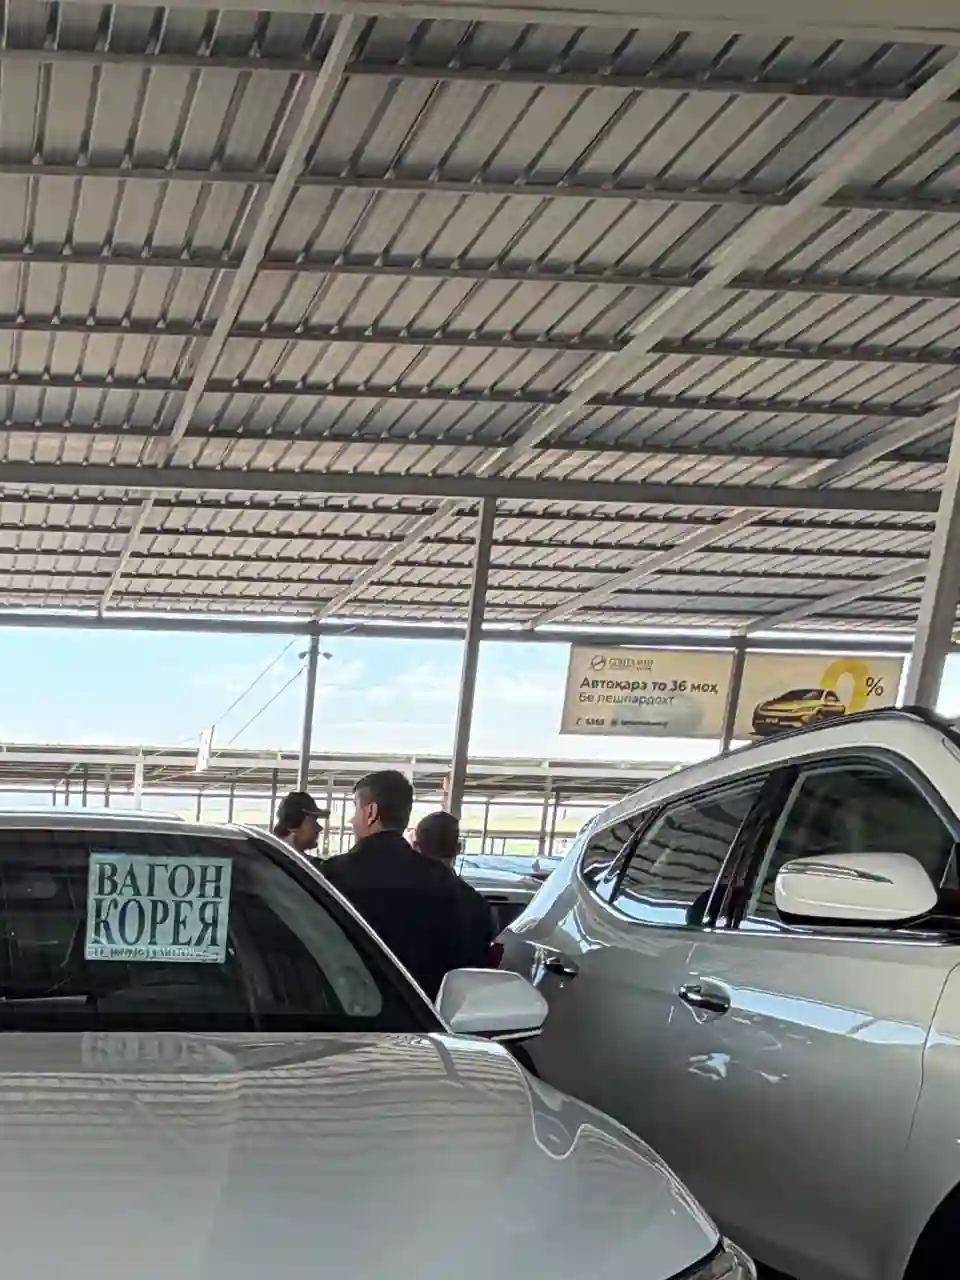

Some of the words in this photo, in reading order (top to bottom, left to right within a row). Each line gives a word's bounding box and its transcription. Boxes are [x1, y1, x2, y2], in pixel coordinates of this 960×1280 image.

[651, 681, 667, 691] то
[669, 680, 687, 692] 36
[94, 862, 224, 899] ВАГОН
[91, 898, 222, 947] КОРЕЯ
